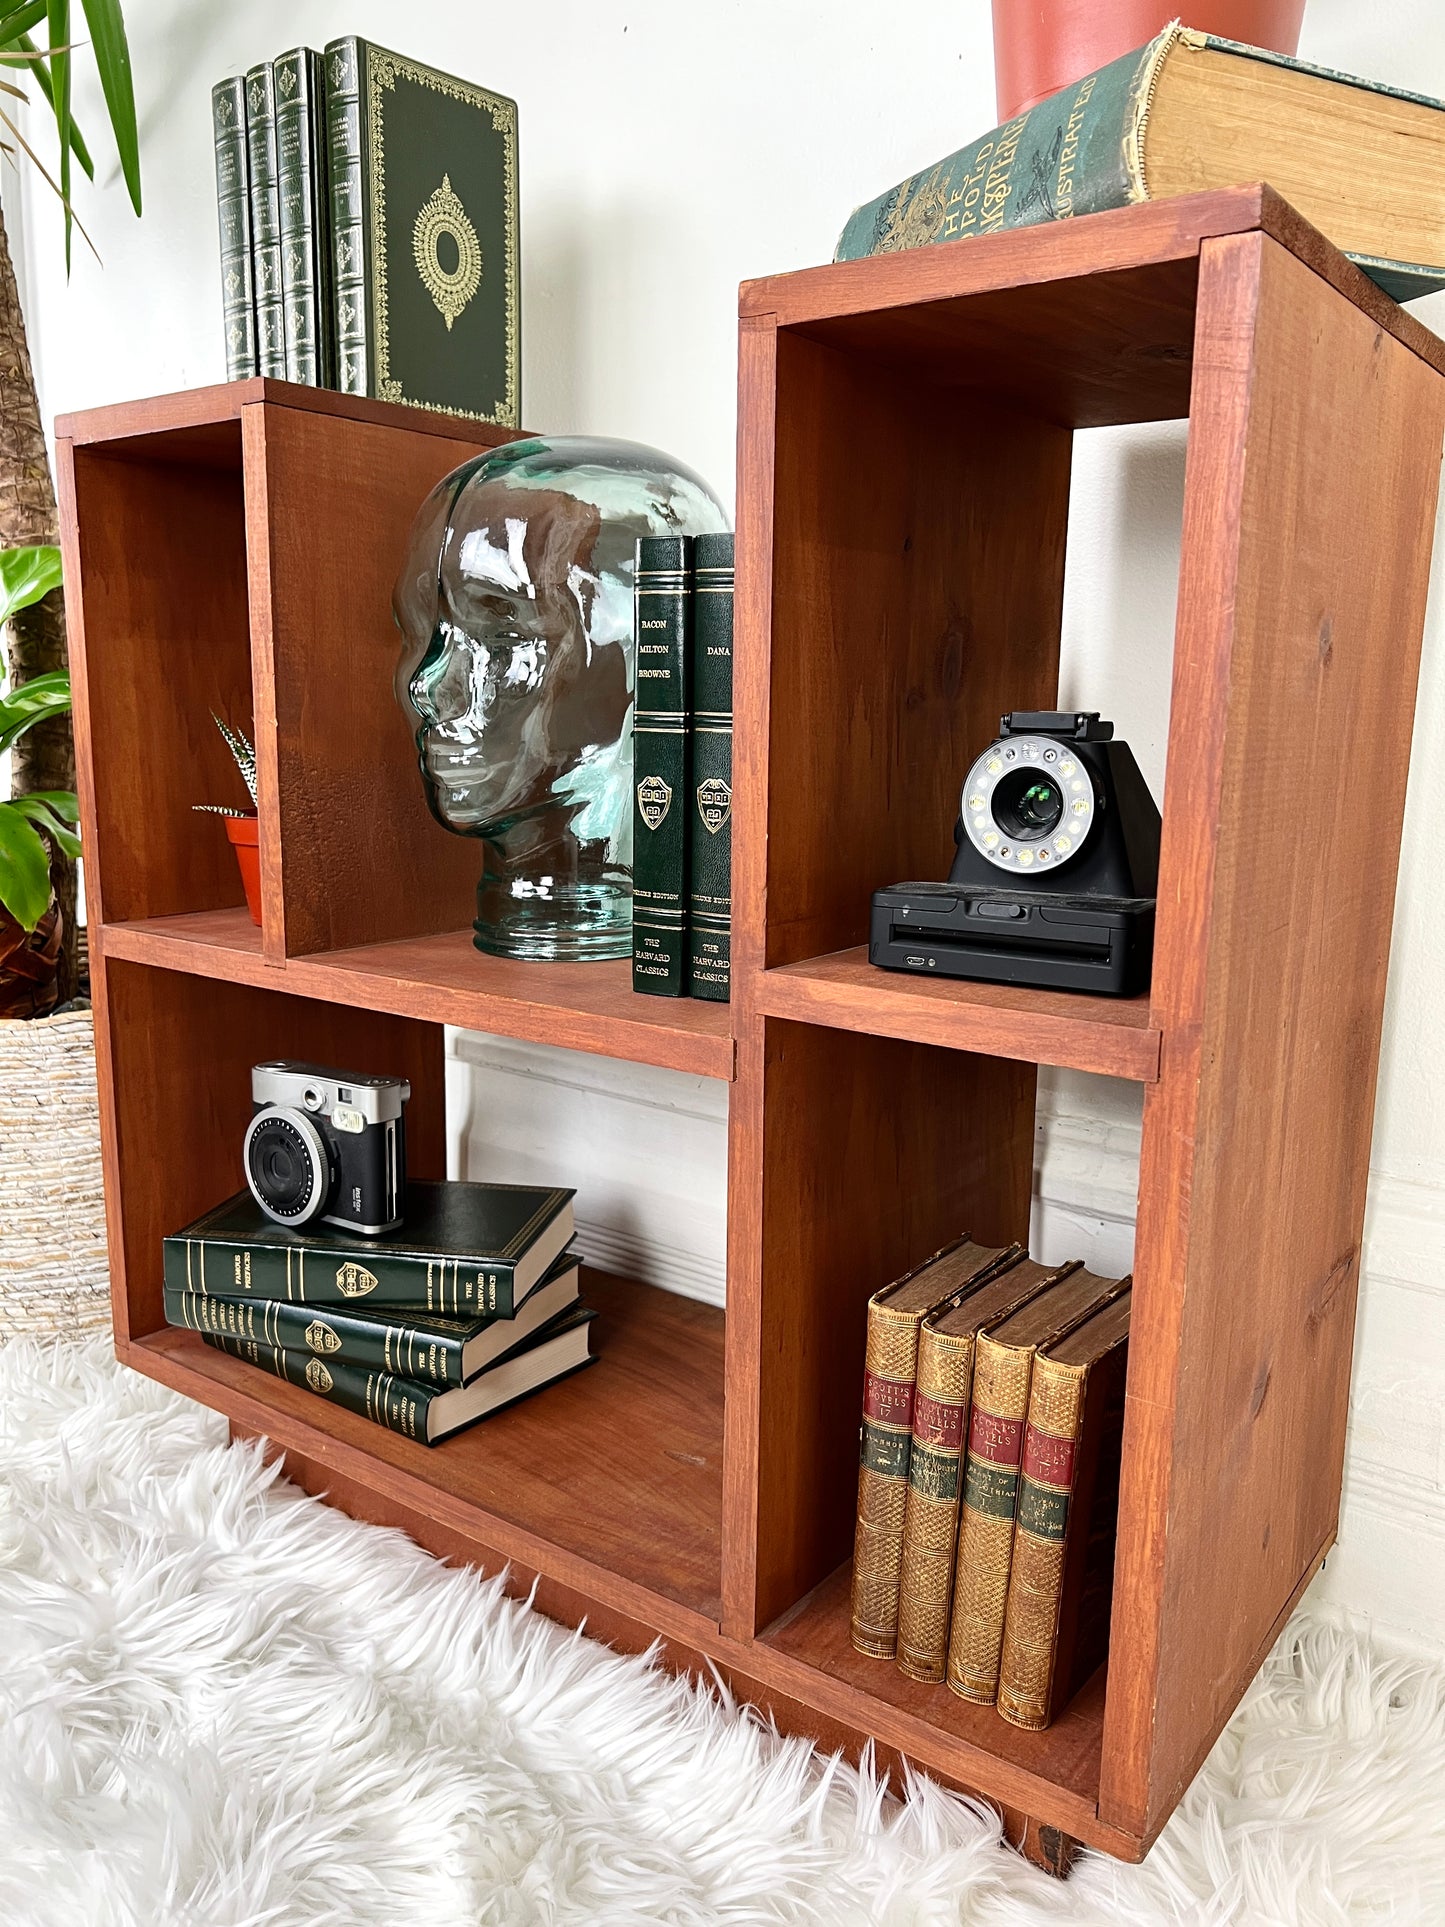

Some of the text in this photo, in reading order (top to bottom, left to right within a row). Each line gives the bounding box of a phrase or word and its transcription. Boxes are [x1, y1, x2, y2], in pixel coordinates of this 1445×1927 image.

[1055, 77, 1097, 220] USTRATED
[980, 112, 1032, 235] KSPERE
[960, 142, 994, 239] POLD
[944, 174, 970, 237] HE
[642, 620, 667, 629] BACON
[640, 645, 669, 654] MILTON
[707, 646, 731, 656] DANA
[638, 670, 671, 679] BROWNE
[652, 892, 679, 900] EDITION
[644, 938, 660, 948] THE
[702, 943, 719, 953] THE
[635, 950, 670, 963] HARVARD
[693, 956, 730, 968] HARVARD
[635, 964, 669, 977] CLASSICS
[693, 970, 728, 983] CLASSICS
[234, 1254, 242, 1285] FAMOUS
[243, 1251, 252, 1289] PREFACES
[465, 1282, 473, 1299] THE
[477, 1272, 485, 1310] HARVARD
[489, 1274, 497, 1310] CLASSICS
[211, 1298, 219, 1330] NEWMAN
[229, 1303, 237, 1333] HUXLEY
[238, 1303, 246, 1337] THOREAU
[418, 1352, 426, 1369] THE
[429, 1343, 438, 1380] HARVARD
[440, 1346, 448, 1381] CLASSICS
[868, 1378, 910, 1399] SCOTT'S
[868, 1388, 906, 1408] NOVELS
[400, 1396, 408, 1433] HARVARD
[880, 1407, 891, 1417] 17
[973, 1412, 1016, 1434] SCOTT'S
